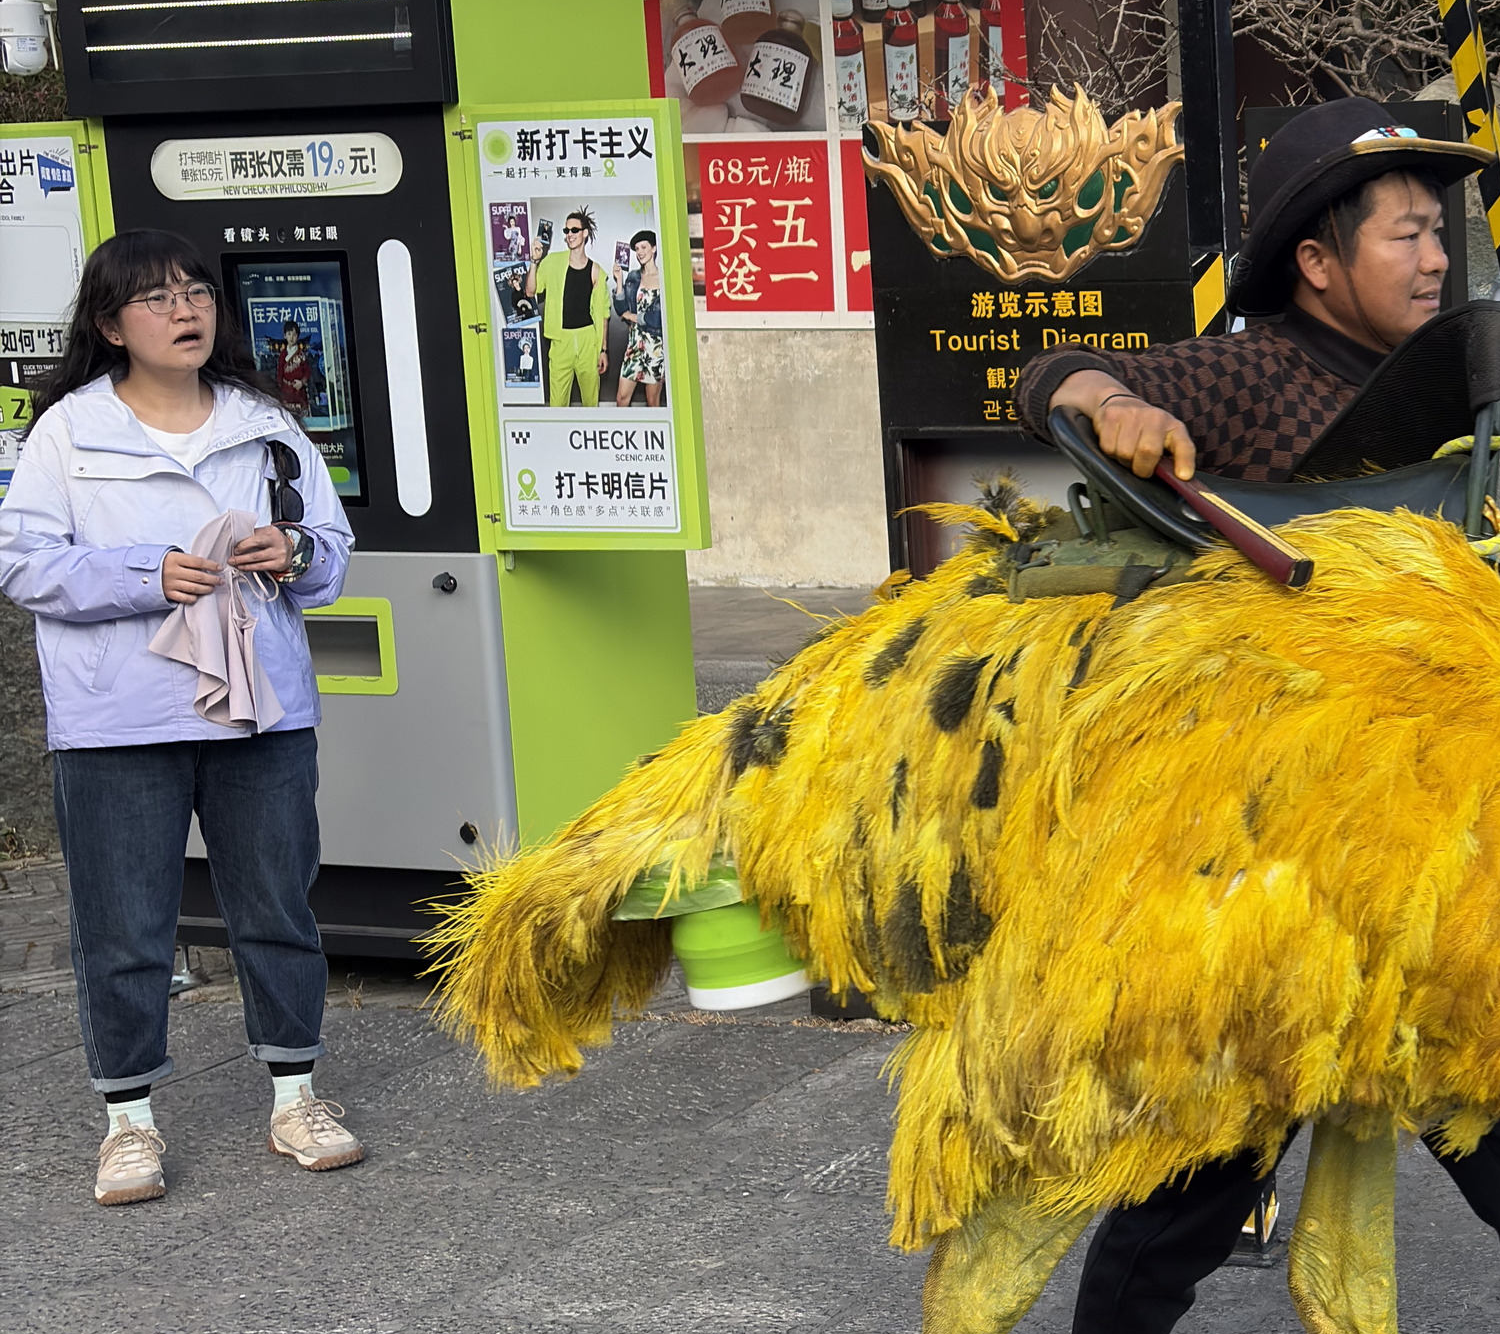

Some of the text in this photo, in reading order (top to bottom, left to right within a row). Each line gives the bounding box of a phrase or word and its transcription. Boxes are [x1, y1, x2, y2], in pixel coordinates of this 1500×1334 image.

[516, 125, 653, 161] 新打卡主义
[179, 151, 223, 166] 打卡明信片
[181, 167, 224, 183] 单张15.9元
[708, 156, 814, 189] 68元/瓶
[223, 182, 328, 196] NEW CHECK-IN PHILOSOPHY
[293, 225, 338, 241] 勿眨眼
[713, 197, 818, 251] 买五
[224, 228, 270, 243] 看镜头
[713, 252, 819, 301] 送一
[253, 306, 319, 323] 在天龙八部
[971, 291, 1103, 318] 游览示意图
[930, 329, 1020, 351] Tourist
[569, 430, 665, 450] CHECK IN
[615, 454, 665, 462] SCENIC AREA
[555, 471, 668, 500] 打卡明信片
